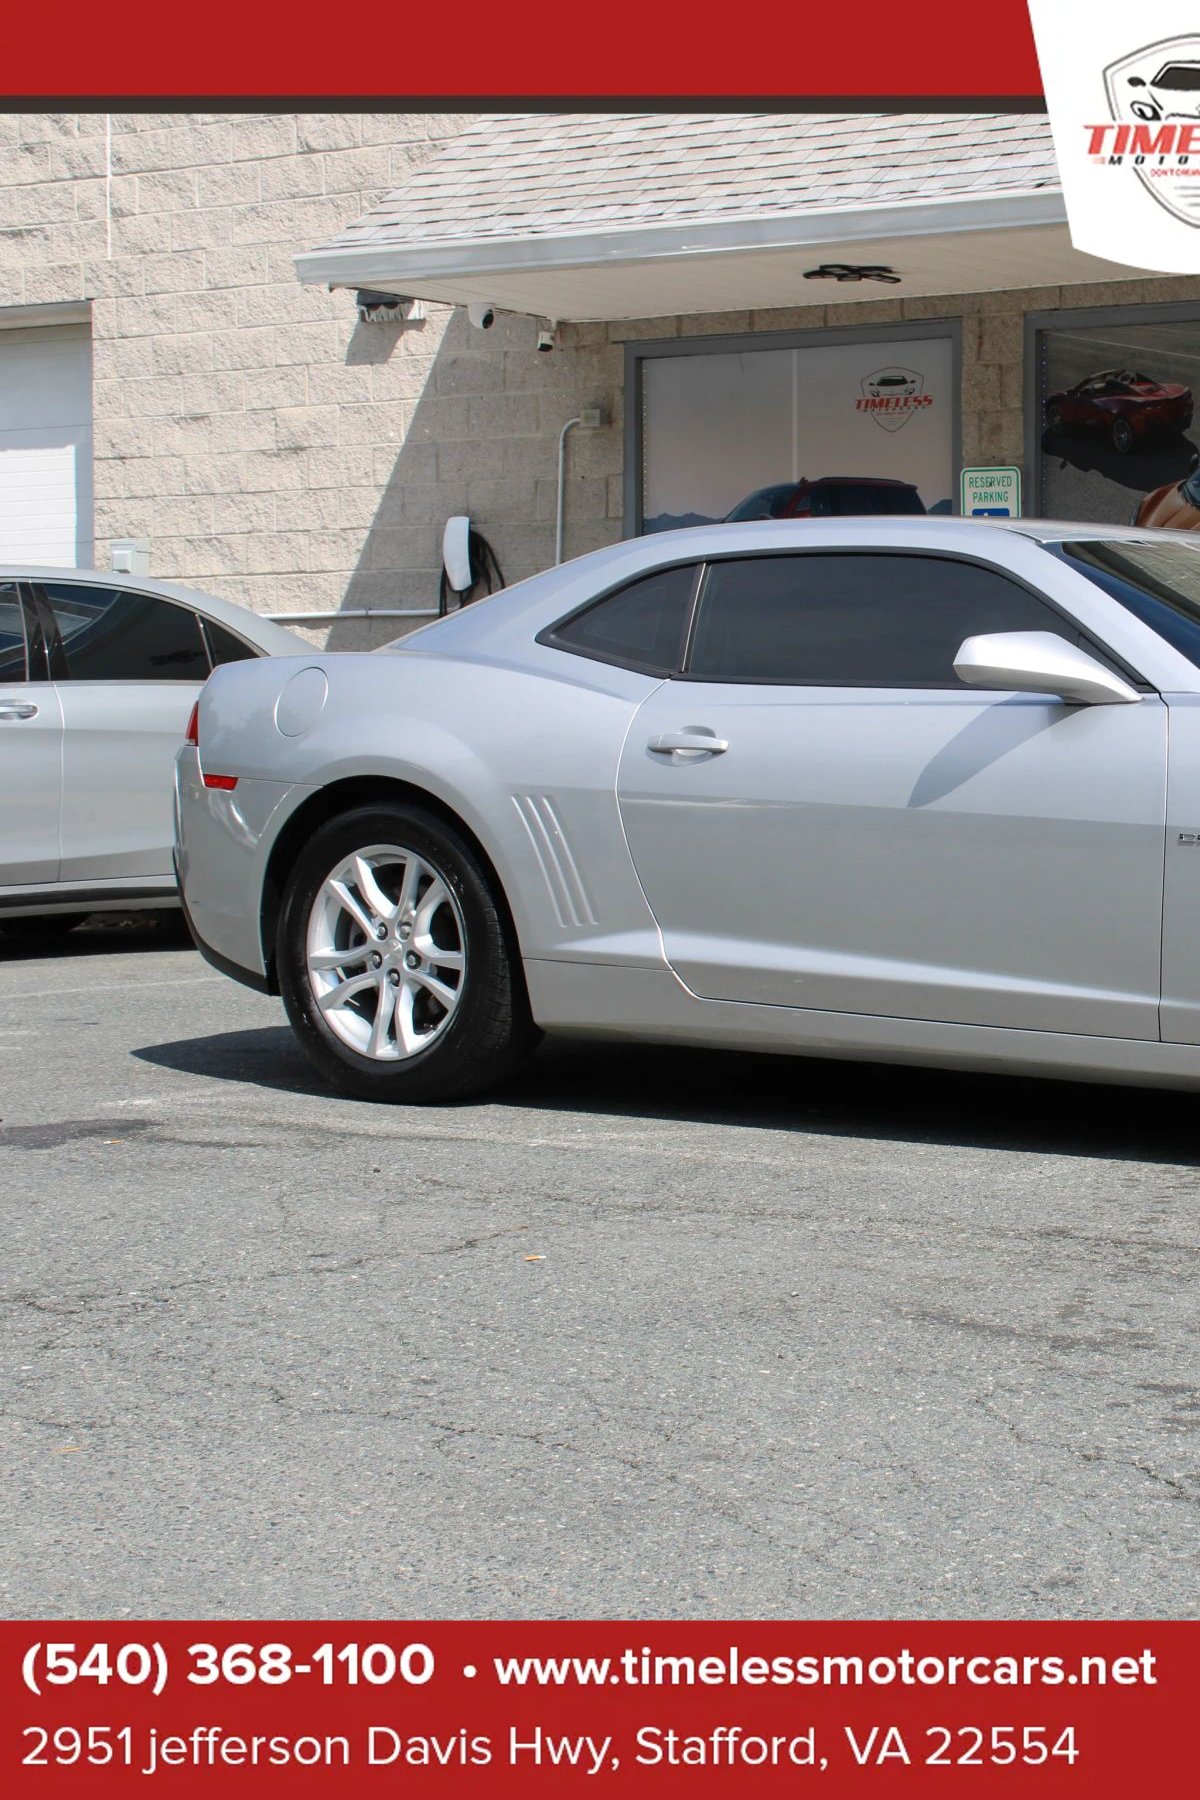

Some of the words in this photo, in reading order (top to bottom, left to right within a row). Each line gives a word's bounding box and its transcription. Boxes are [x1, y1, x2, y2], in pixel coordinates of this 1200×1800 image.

[855, 395, 934, 410] TIMELESS
[968, 476, 1012, 488] RESERVED
[973, 491, 1009, 502] PARKING
